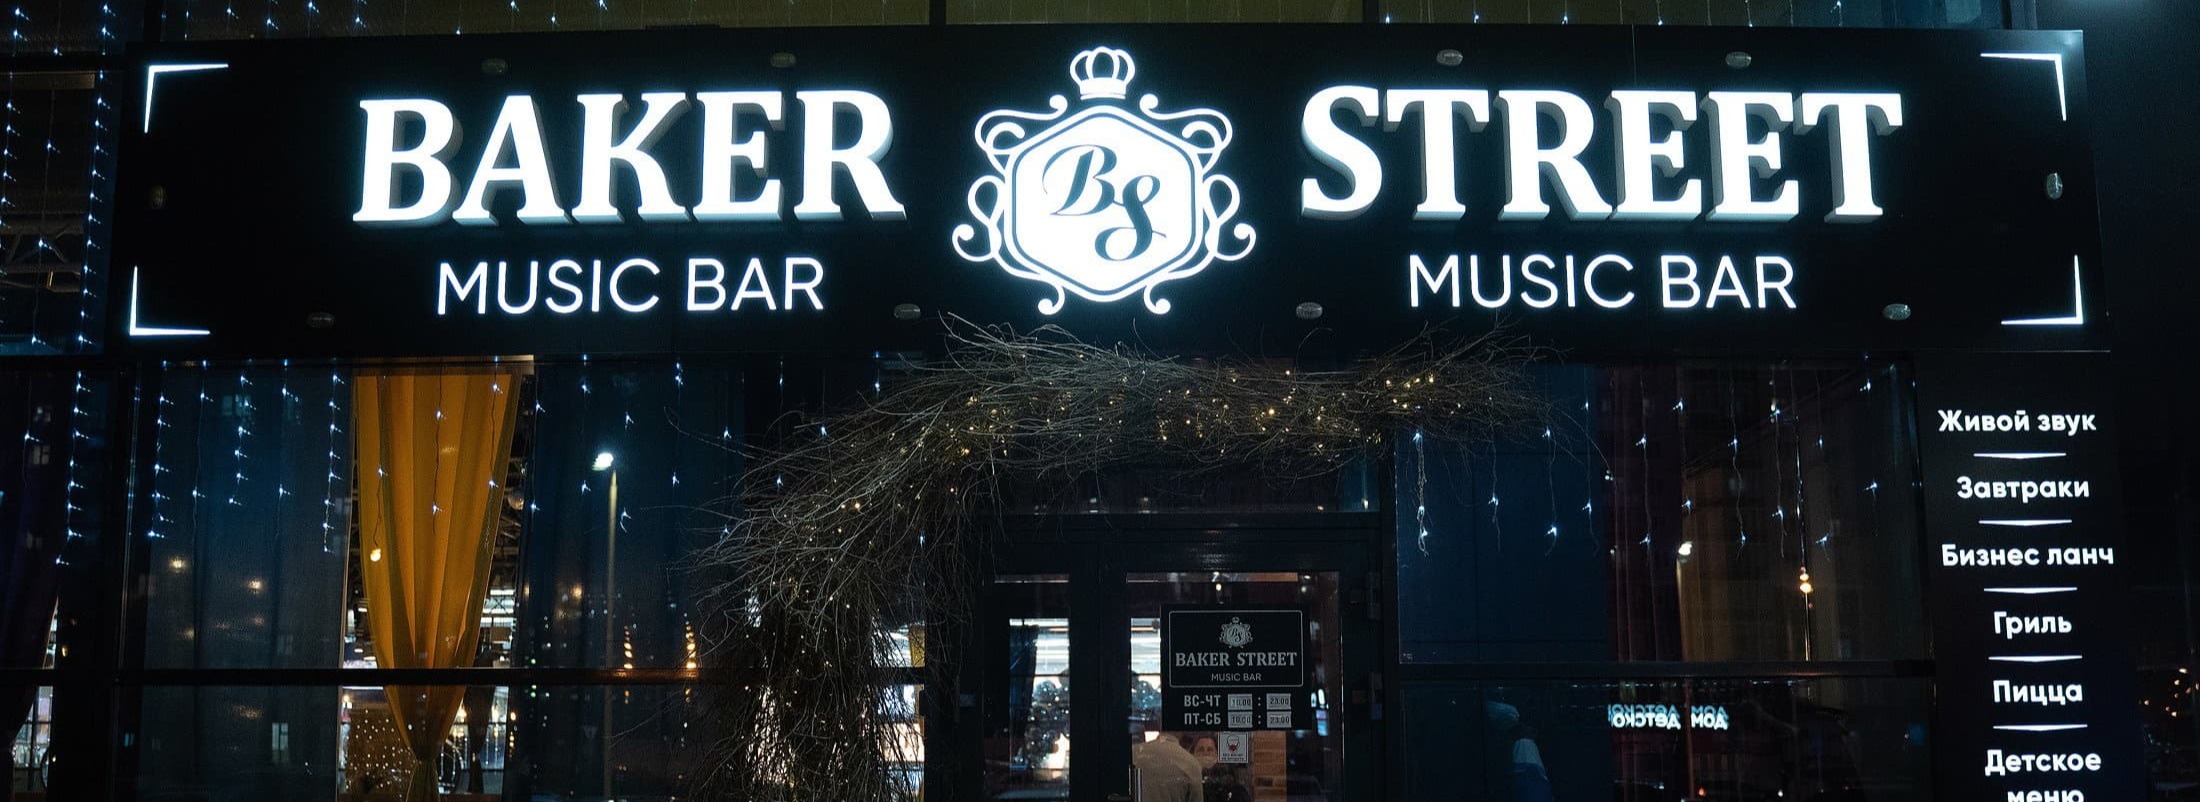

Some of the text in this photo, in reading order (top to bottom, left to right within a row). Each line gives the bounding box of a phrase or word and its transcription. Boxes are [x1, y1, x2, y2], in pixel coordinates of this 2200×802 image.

[353, 85, 1903, 225] BAKER STREET
[437, 256, 824, 315] MUSIC BAR
[1409, 253, 1797, 309] MUSIC BAR
[1937, 409, 2097, 437] Живой звук
[1956, 475, 2090, 504] Завтраки
[1941, 543, 2114, 567] Бизнес ланч
[1993, 611, 2072, 640] Гриль
[1175, 652, 1298, 667] BAKER STREET
[1211, 673, 1262, 682] MUSIC BAR
[1183, 694, 1221, 707] ВС-ЧТ
[1993, 679, 2083, 706] Пицца
[1184, 712, 1221, 725] ПТ-СБ
[1984, 749, 2102, 777] Детское
[2007, 789, 2085, 802] меню
